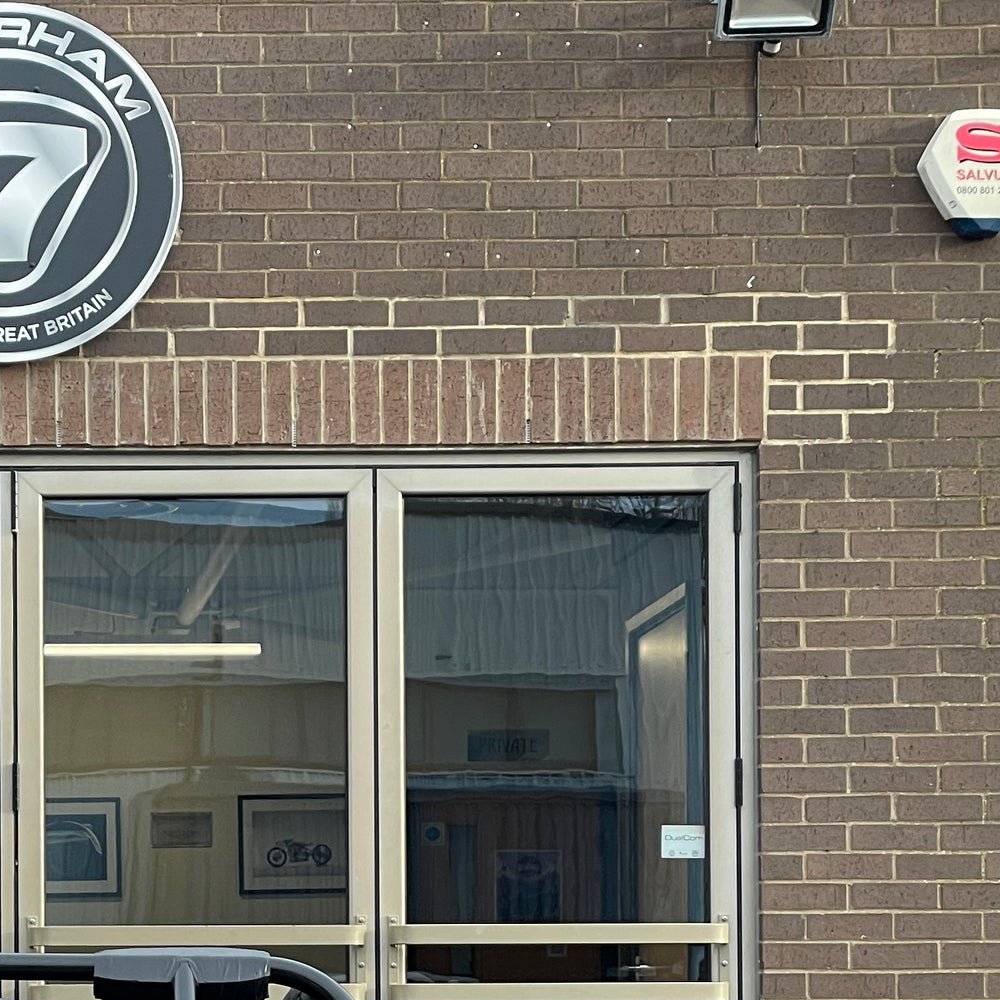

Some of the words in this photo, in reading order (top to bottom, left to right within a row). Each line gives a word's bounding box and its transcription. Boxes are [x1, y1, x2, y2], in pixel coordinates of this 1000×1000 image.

[956, 186, 977, 194] 0800
[979, 186, 994, 194] 801
[45, 288, 113, 336] BRITAIN
